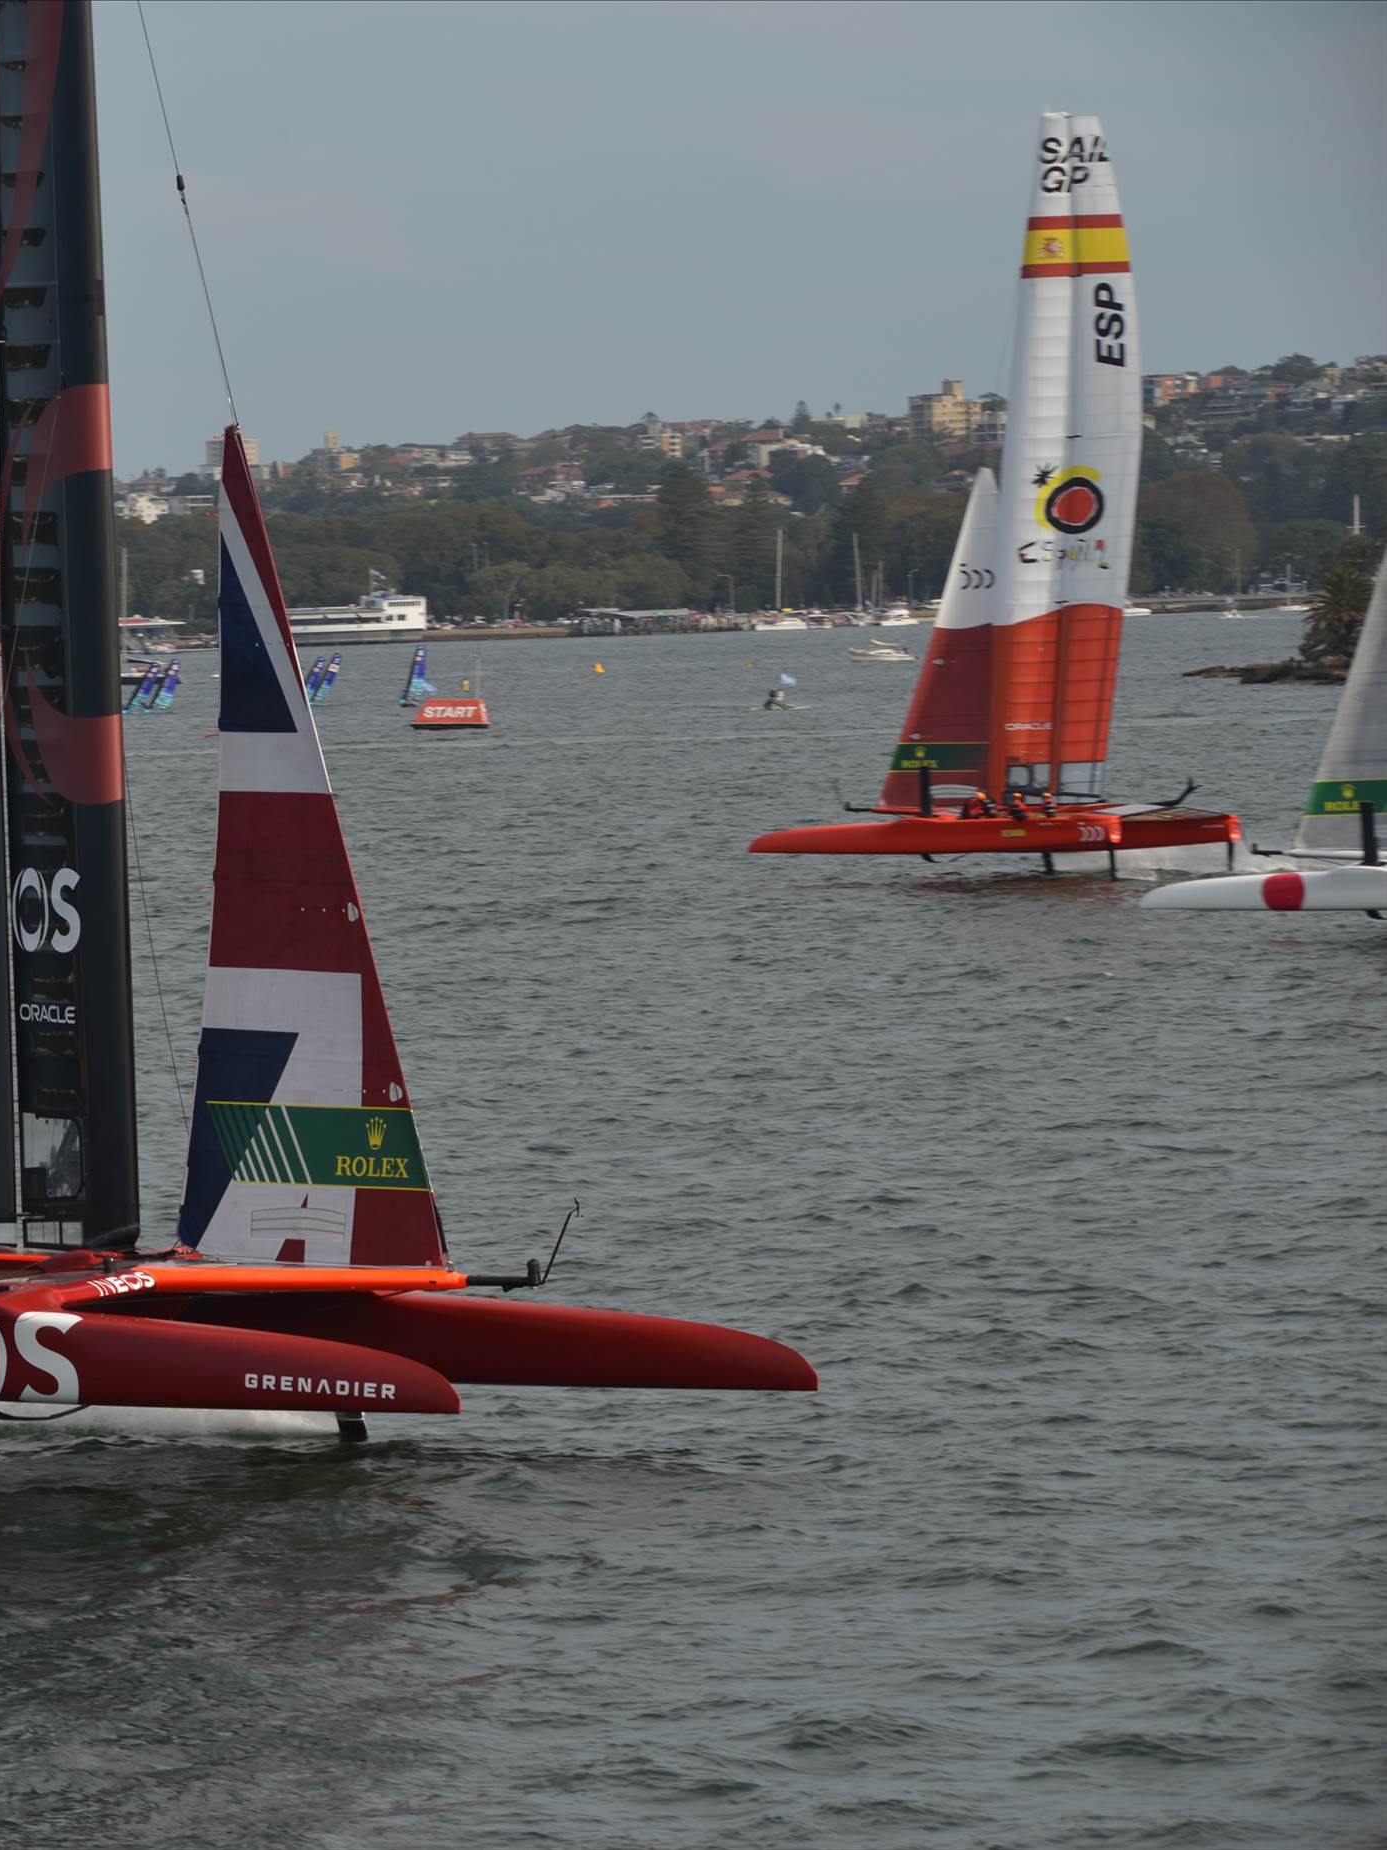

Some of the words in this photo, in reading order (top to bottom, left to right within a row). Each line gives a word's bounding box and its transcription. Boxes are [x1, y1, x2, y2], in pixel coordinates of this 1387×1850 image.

[1039, 134, 1110, 164] SAIL
[1040, 166, 1090, 193] GP
[1094, 282, 1126, 367] ESP
[423, 706, 478, 718] START
[20, 1003, 76, 1024] ORACLE
[335, 1155, 409, 1178] ROLEX
[87, 1271, 155, 1297] INEOS
[245, 1373, 396, 1400] GRENADIER
